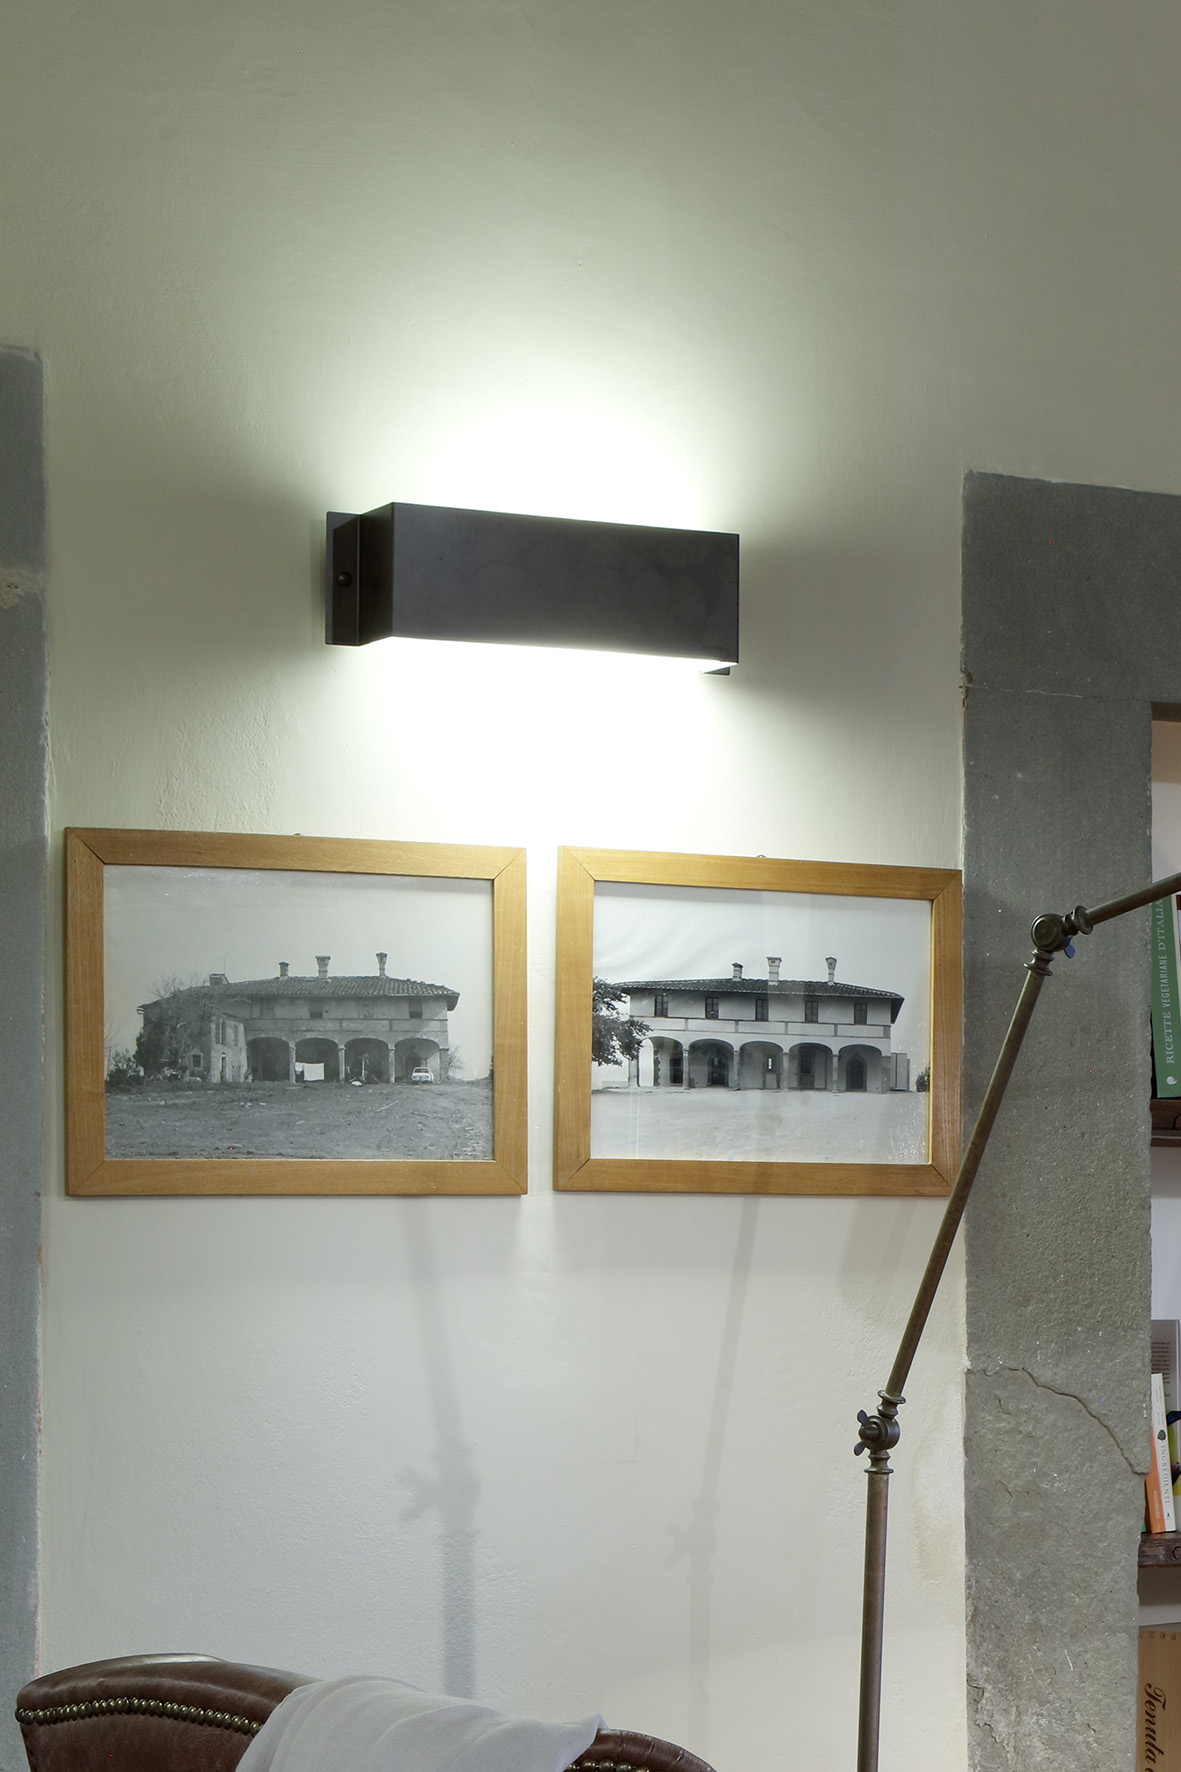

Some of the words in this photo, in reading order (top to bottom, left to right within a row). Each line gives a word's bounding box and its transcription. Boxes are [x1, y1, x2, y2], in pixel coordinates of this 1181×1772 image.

[1155, 899, 1166, 950] D'ITALIA
[1158, 954, 1170, 1008] VEGETARIANE
[1163, 1011, 1174, 1064] RICETTE
[1160, 1445, 1170, 1504] INGREDIENTI
[1144, 1682, 1167, 1765] Tenuta
